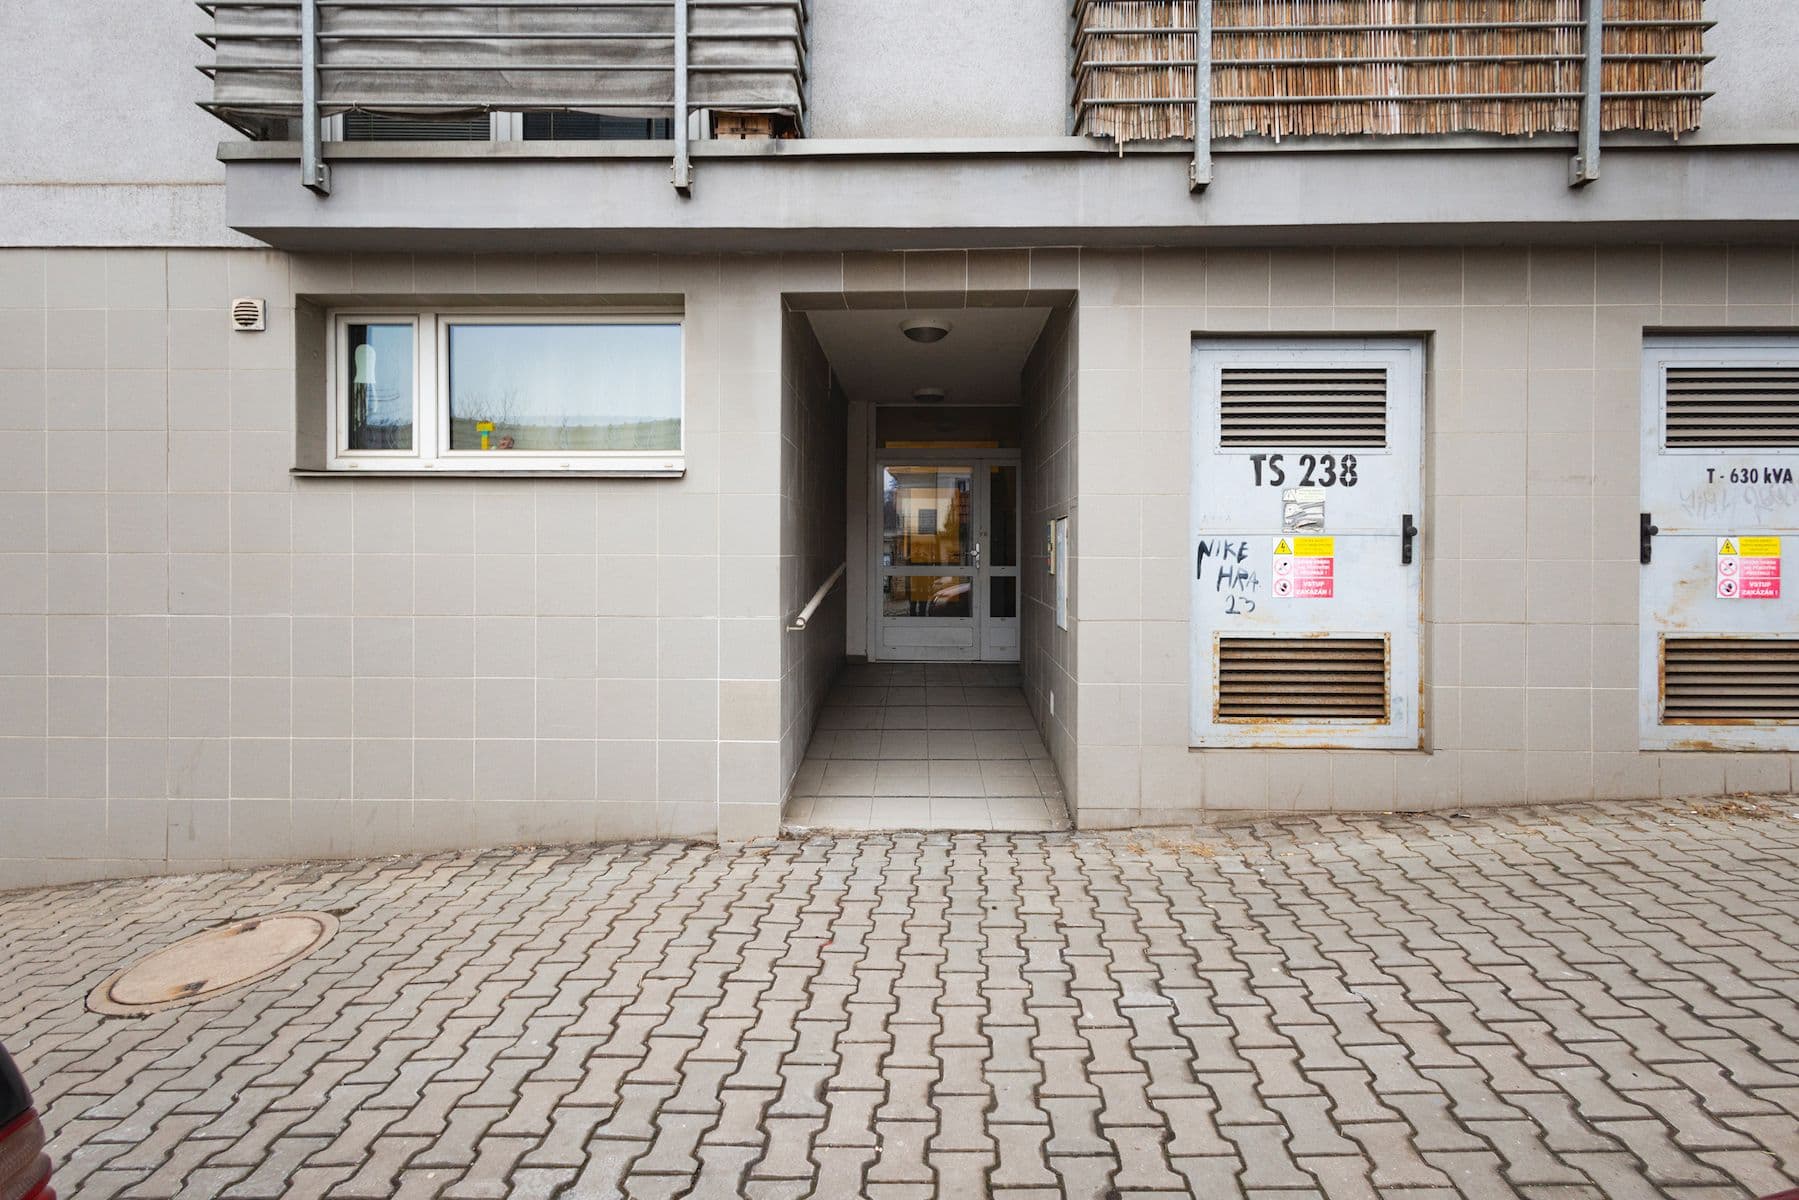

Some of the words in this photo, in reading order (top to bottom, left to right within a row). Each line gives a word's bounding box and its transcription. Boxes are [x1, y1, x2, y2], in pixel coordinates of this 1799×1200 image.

[1250, 454, 1285, 487] TS
[1299, 454, 1358, 487] 238
[1706, 468, 1716, 484] T
[1730, 467, 1759, 484] 630
[1763, 466, 1794, 484] kVA
[1197, 539, 1248, 580] NIKE
